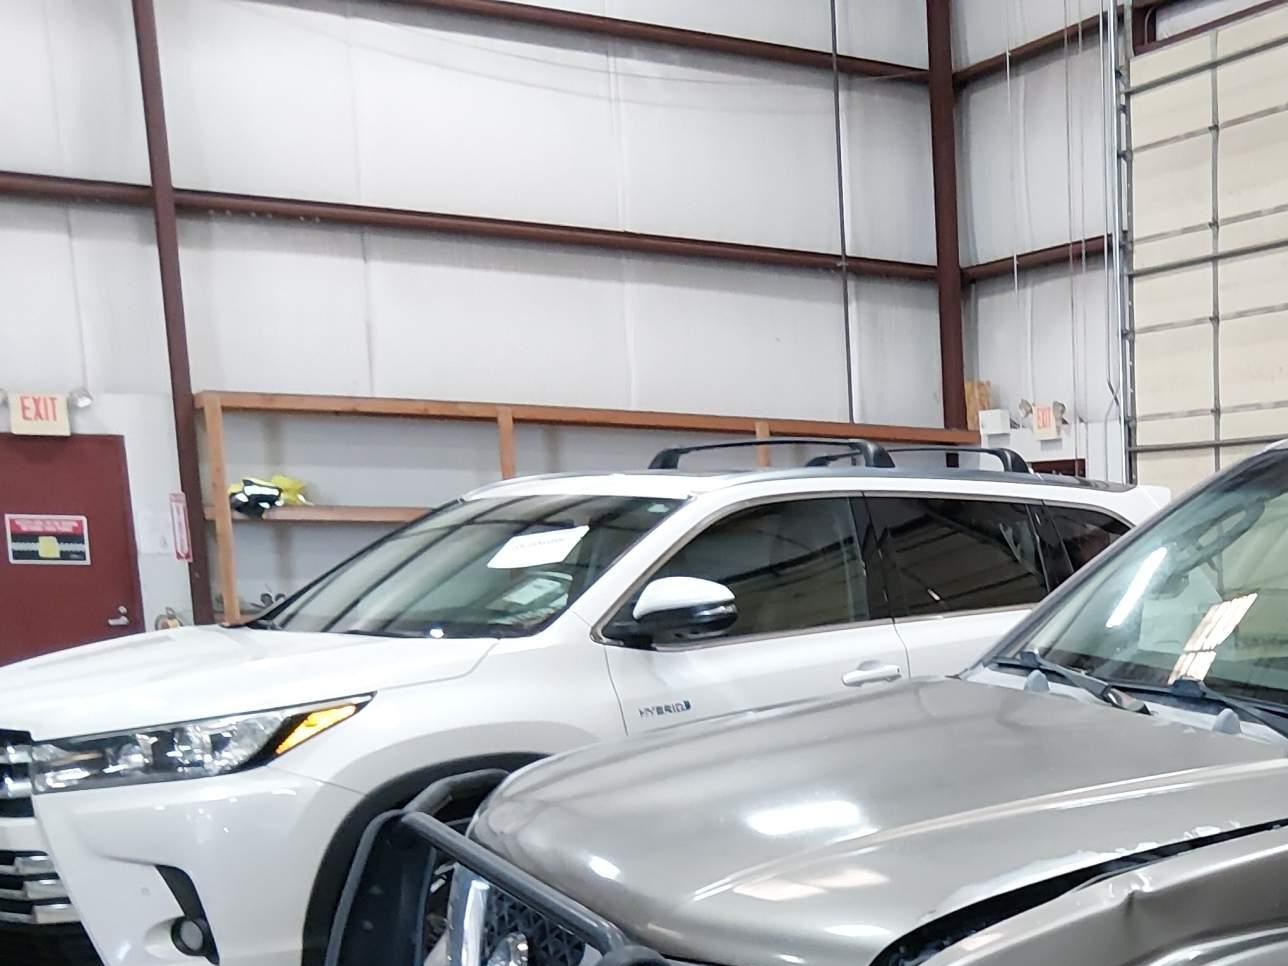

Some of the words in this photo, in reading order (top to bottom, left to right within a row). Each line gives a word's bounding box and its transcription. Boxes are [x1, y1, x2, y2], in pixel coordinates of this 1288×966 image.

[21, 396, 58, 422] EXIT
[1036, 406, 1051, 429] EXIT
[639, 703, 686, 719] HYBRID
